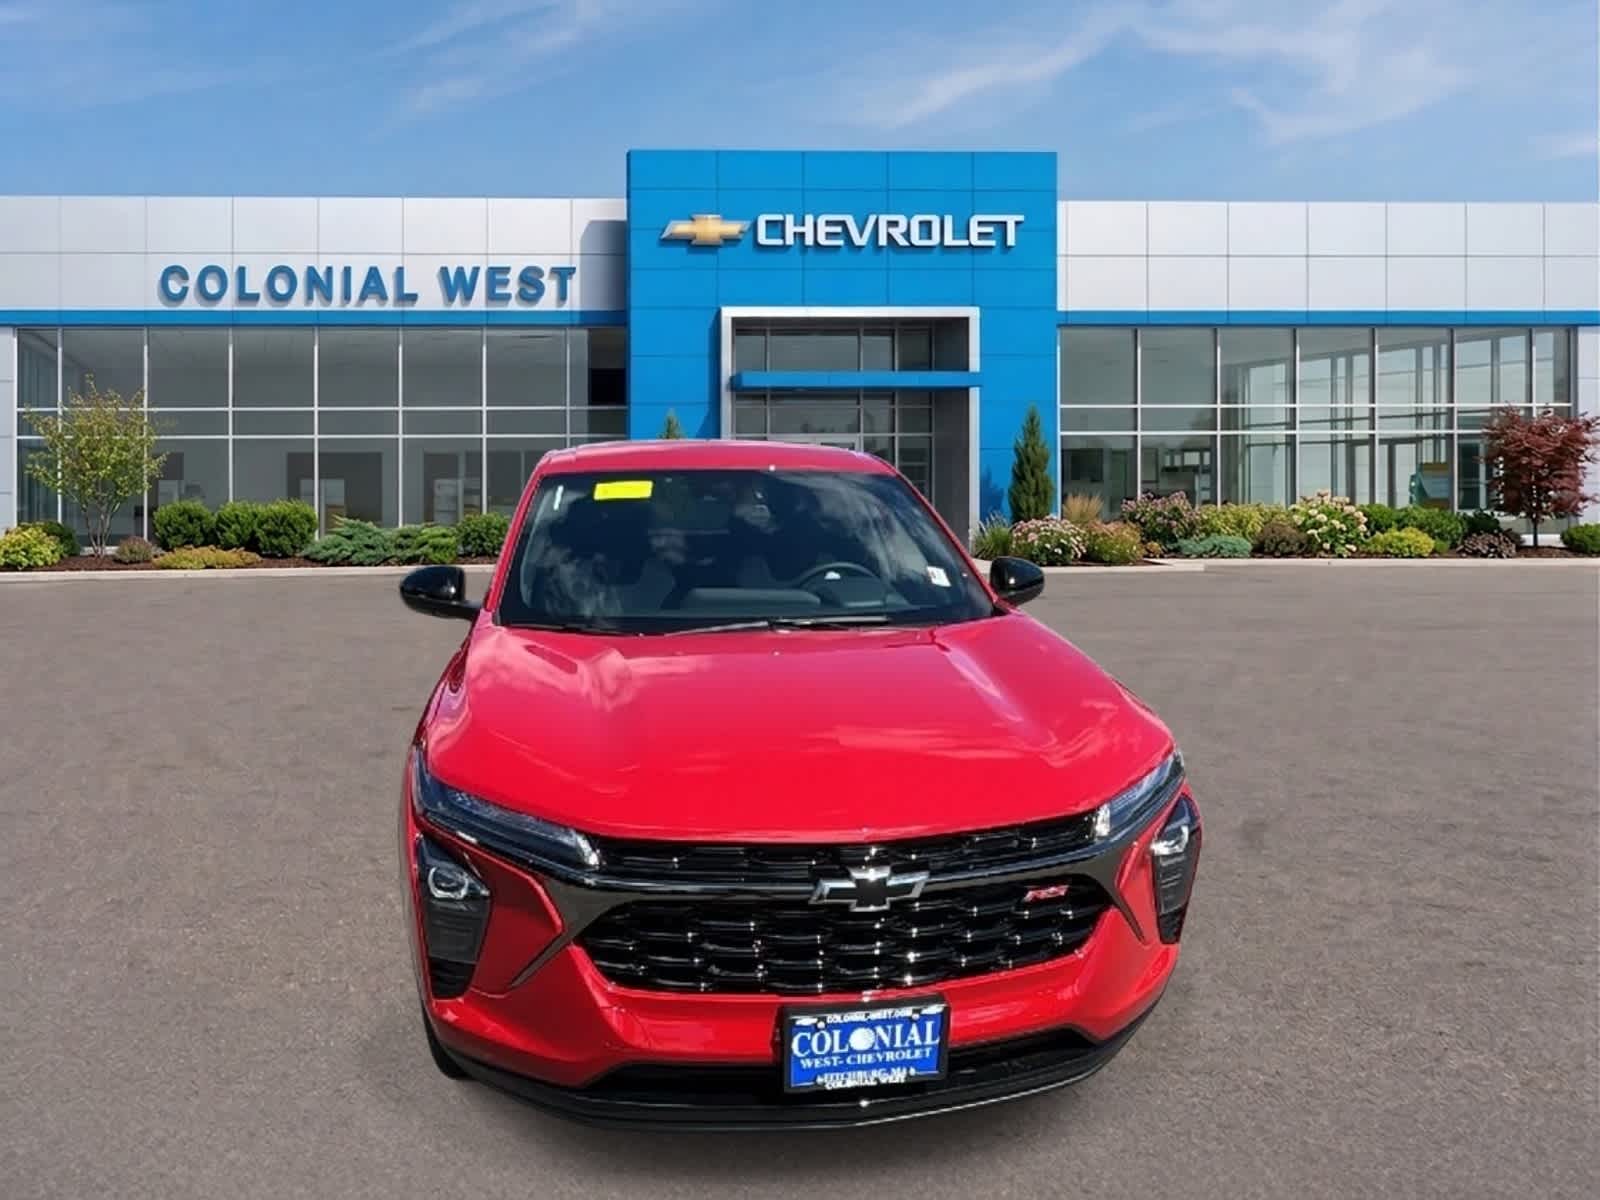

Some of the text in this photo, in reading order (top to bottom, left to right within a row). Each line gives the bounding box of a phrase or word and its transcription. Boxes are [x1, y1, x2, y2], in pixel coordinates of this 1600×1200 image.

[756, 214, 1025, 247] CHEVROLET
[159, 264, 577, 303] COLONIAL WEST
[791, 1020, 941, 1058] COLONIAL
[846, 1047, 932, 1065] CHEVROLET
